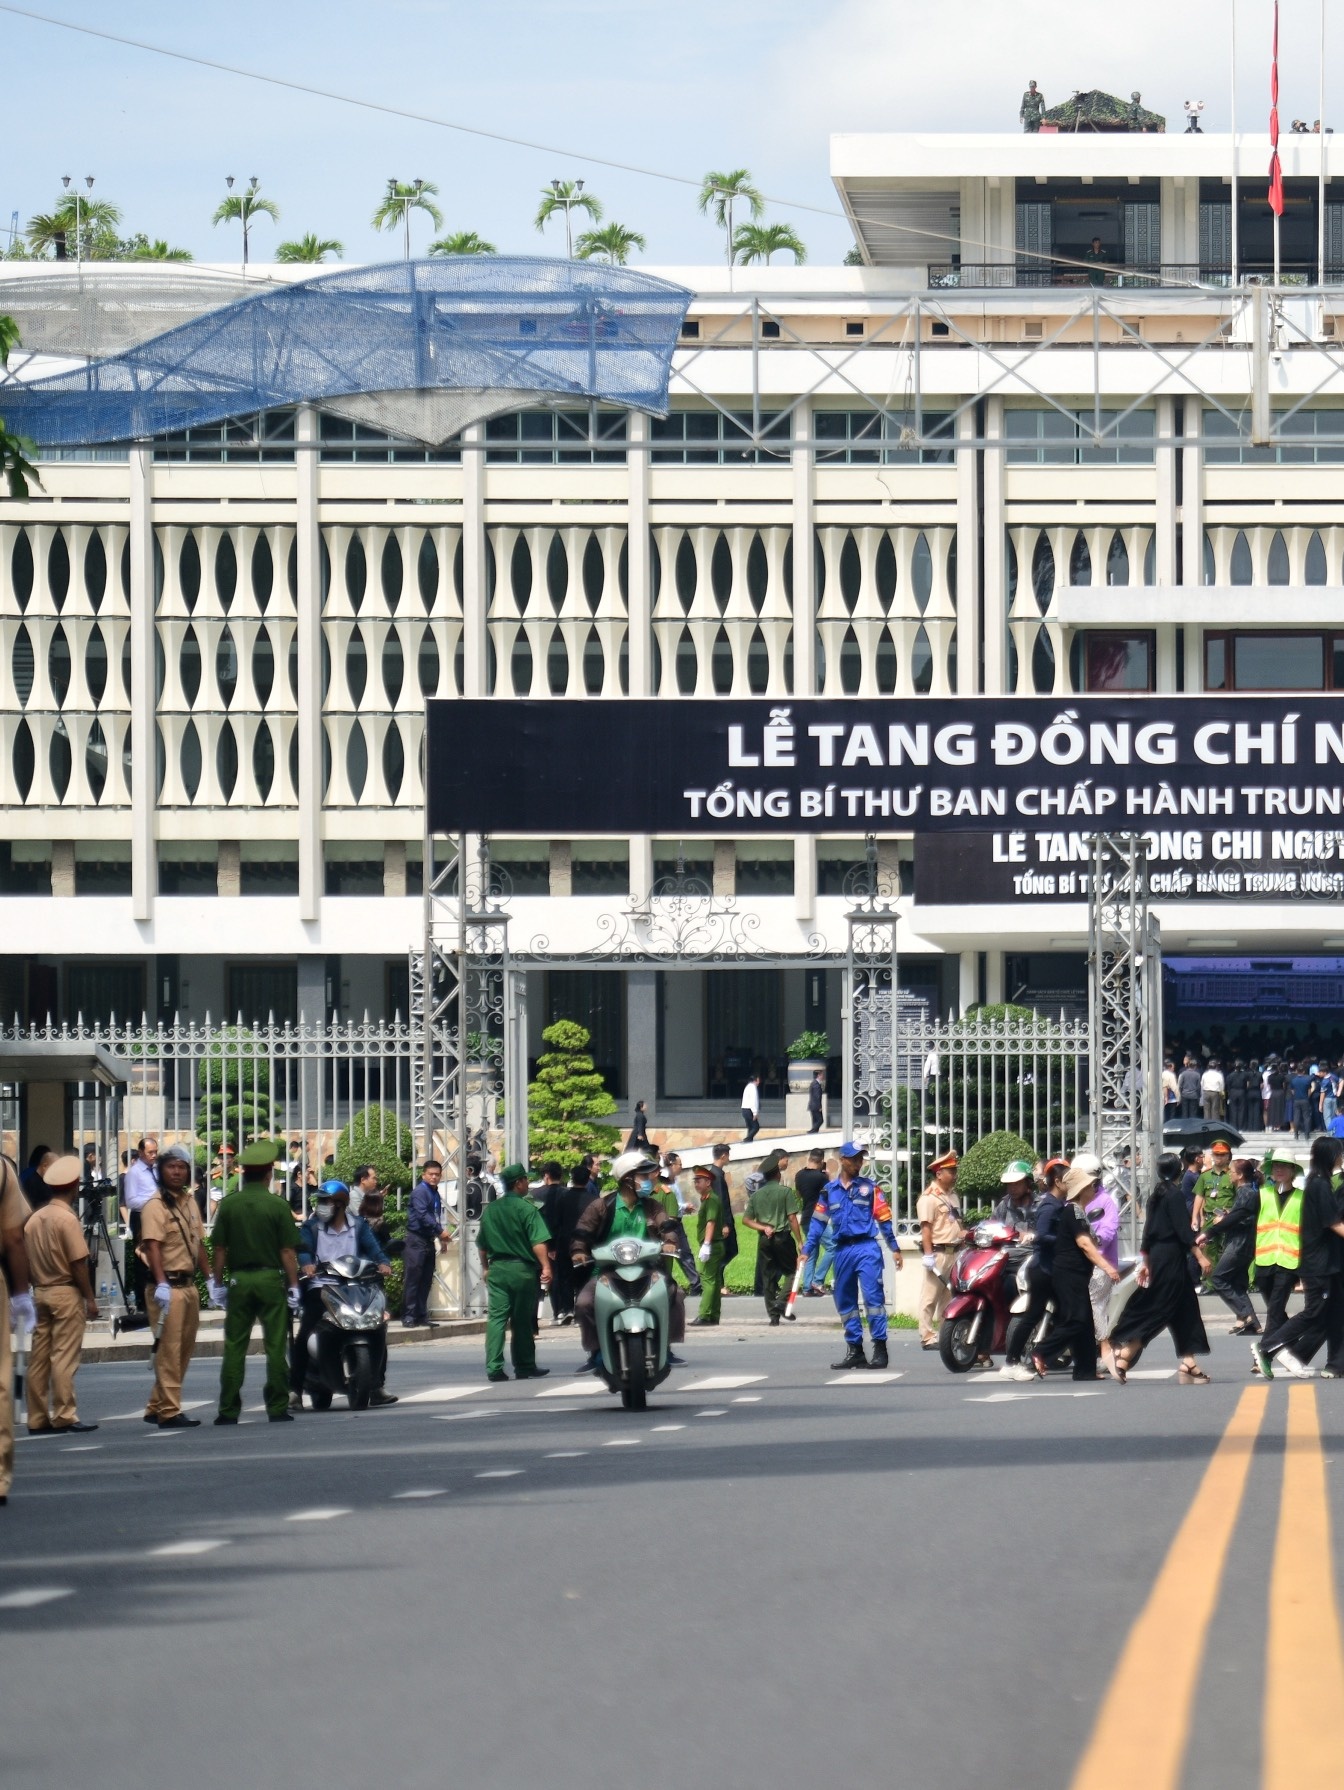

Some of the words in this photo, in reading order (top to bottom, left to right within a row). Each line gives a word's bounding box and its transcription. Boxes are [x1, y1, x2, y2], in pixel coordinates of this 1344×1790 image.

[728, 708, 795, 766] LỄ
[808, 722, 976, 766] TANG
[991, 709, 1177, 765] ĐỒNG
[1193, 713, 1301, 764] CHÍ
[684, 781, 790, 818] TỔNG
[800, 784, 837, 816] BÍ
[841, 784, 923, 817] THƯ
[930, 788, 1006, 816] BAN
[1015, 780, 1118, 815] CHẤP
[1126, 781, 1234, 815] HÀNH
[1059, 871, 1076, 893] BÍ
